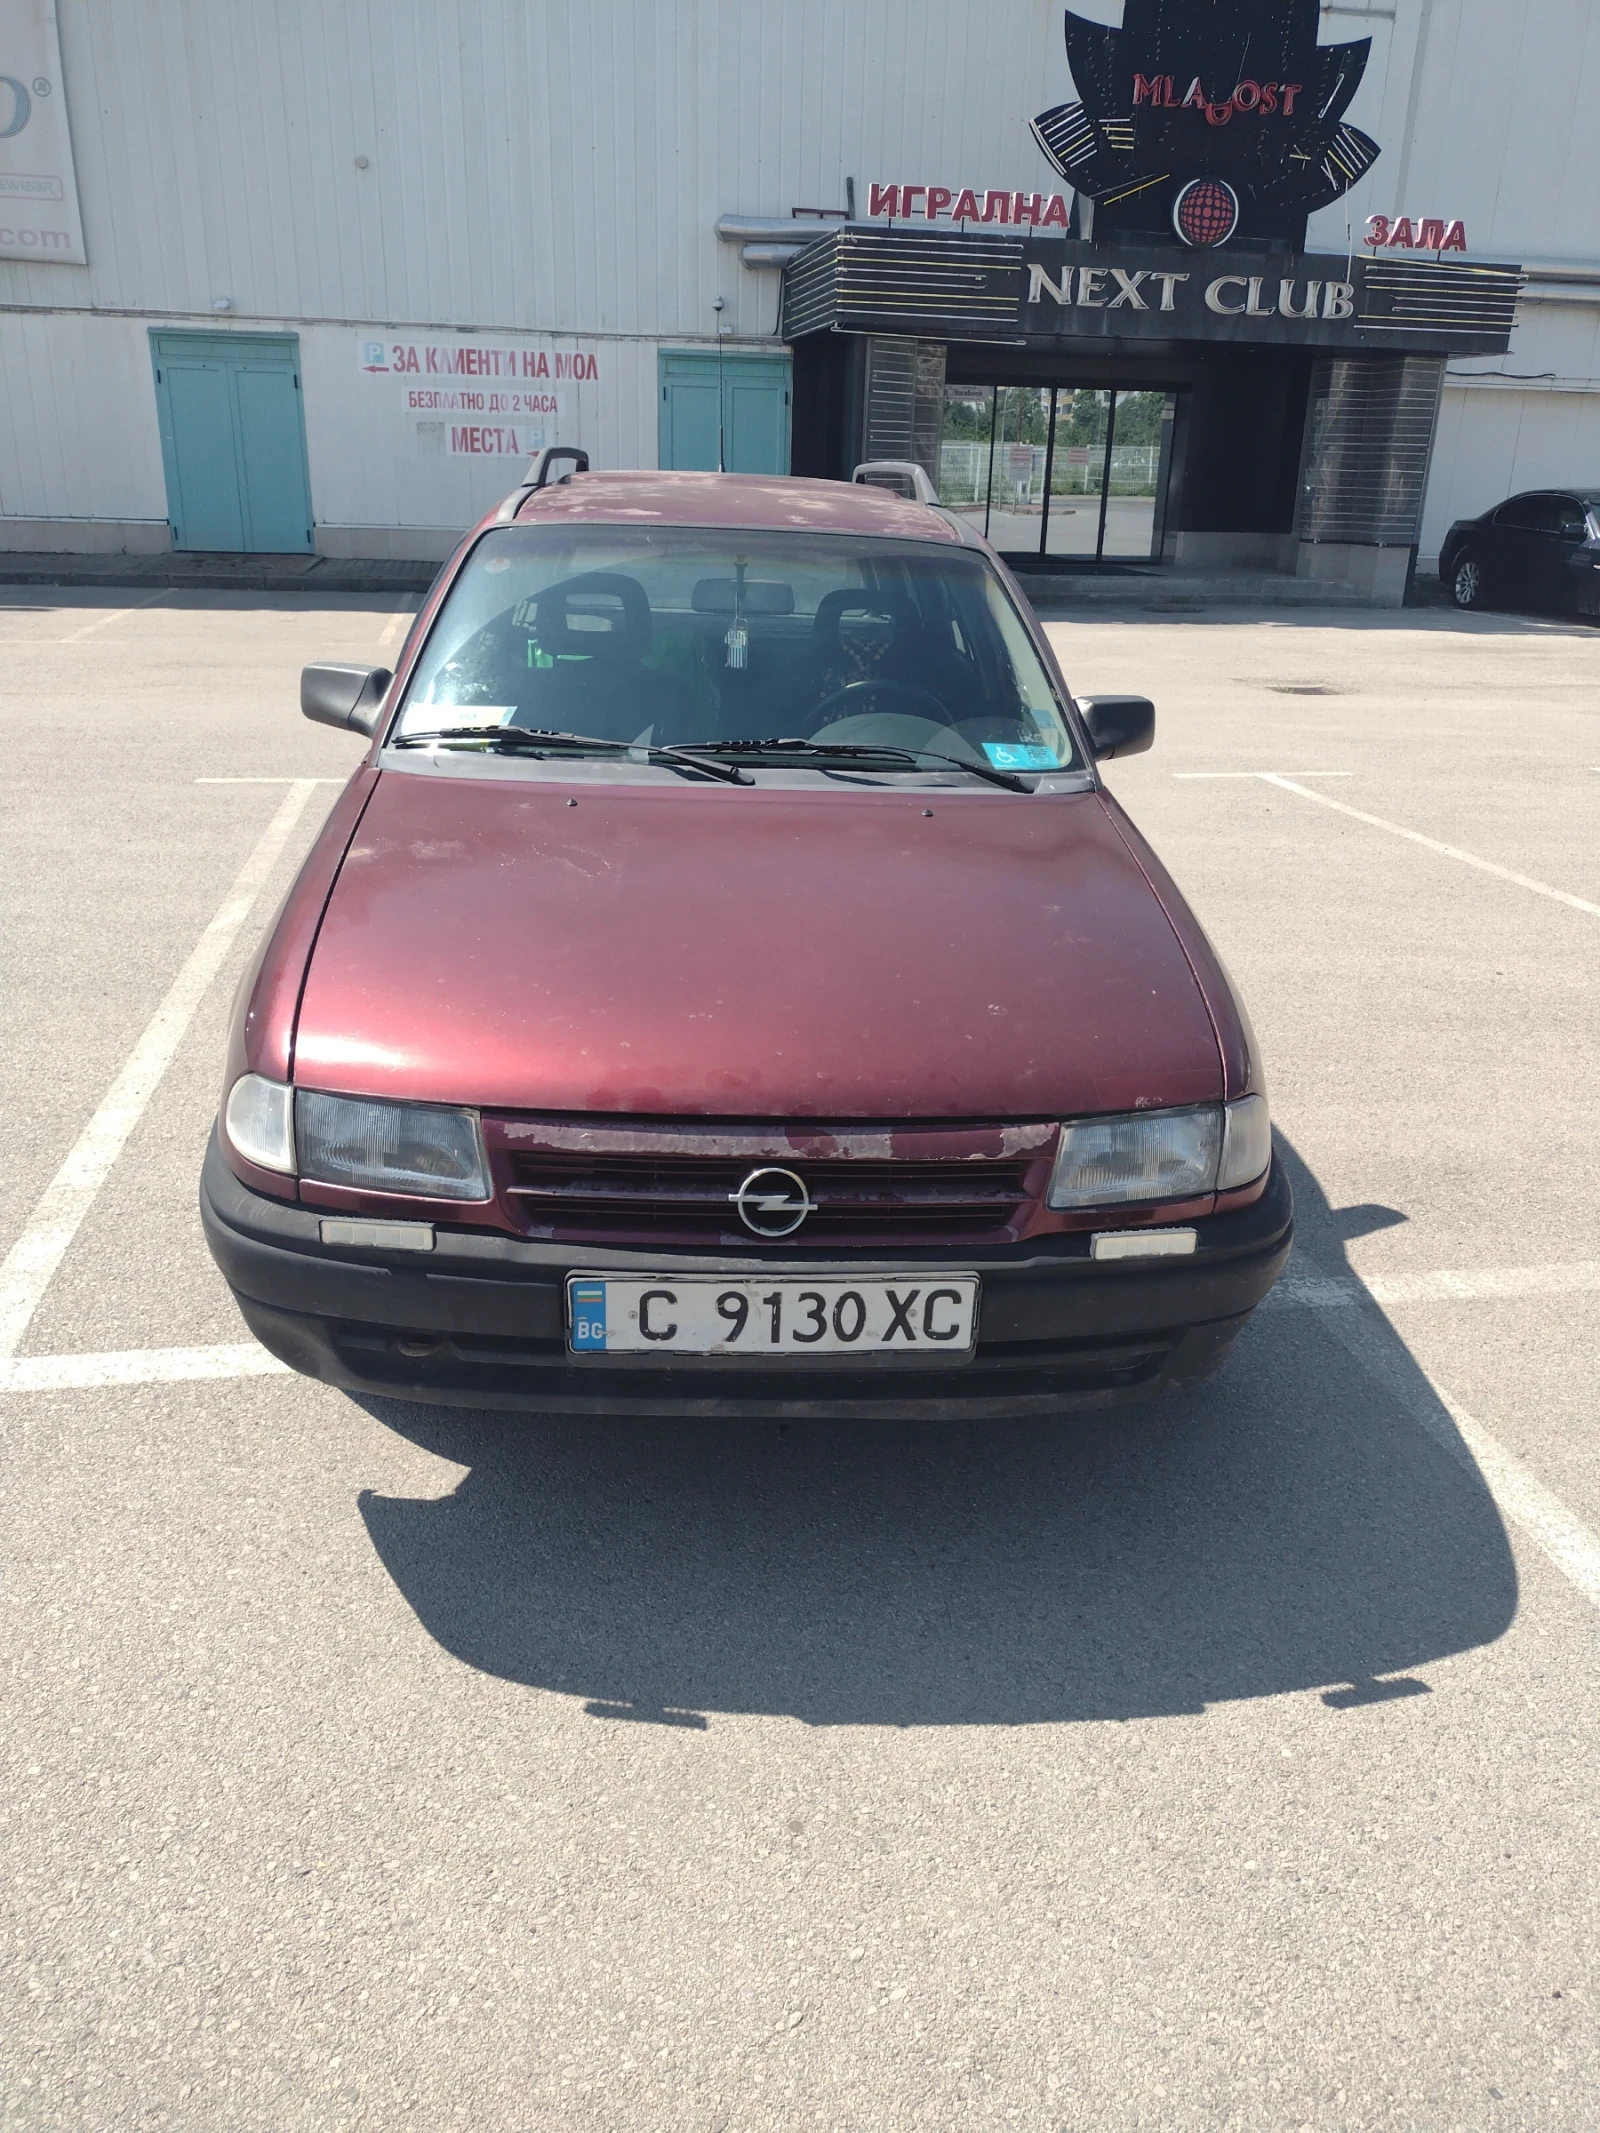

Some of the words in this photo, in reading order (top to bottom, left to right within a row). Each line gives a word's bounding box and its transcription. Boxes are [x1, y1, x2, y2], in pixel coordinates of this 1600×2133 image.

[868, 182, 1070, 228] ИГРАЛНА
[1363, 213, 1467, 252] ЗАЛА
[1027, 262, 1190, 311] NEXT
[1204, 275, 1355, 319] CLUB
[392, 345, 420, 373] ЗА
[425, 346, 516, 377] КЛИЕНТИ
[523, 351, 550, 379] НА
[555, 352, 599, 381] МОЛ
[408, 390, 484, 410] БЕЗПЛАТНО
[489, 393, 508, 414] ДО
[512, 394, 521, 412] 2
[524, 394, 558, 413] ЧАСА
[954, 388, 983, 397] facebook
[451, 425, 519, 455] МЕСТА
[577, 1321, 603, 1340] BG
[638, 1289, 678, 1342] C
[713, 1289, 867, 1344] 9130
[881, 1287, 963, 1342] XC
